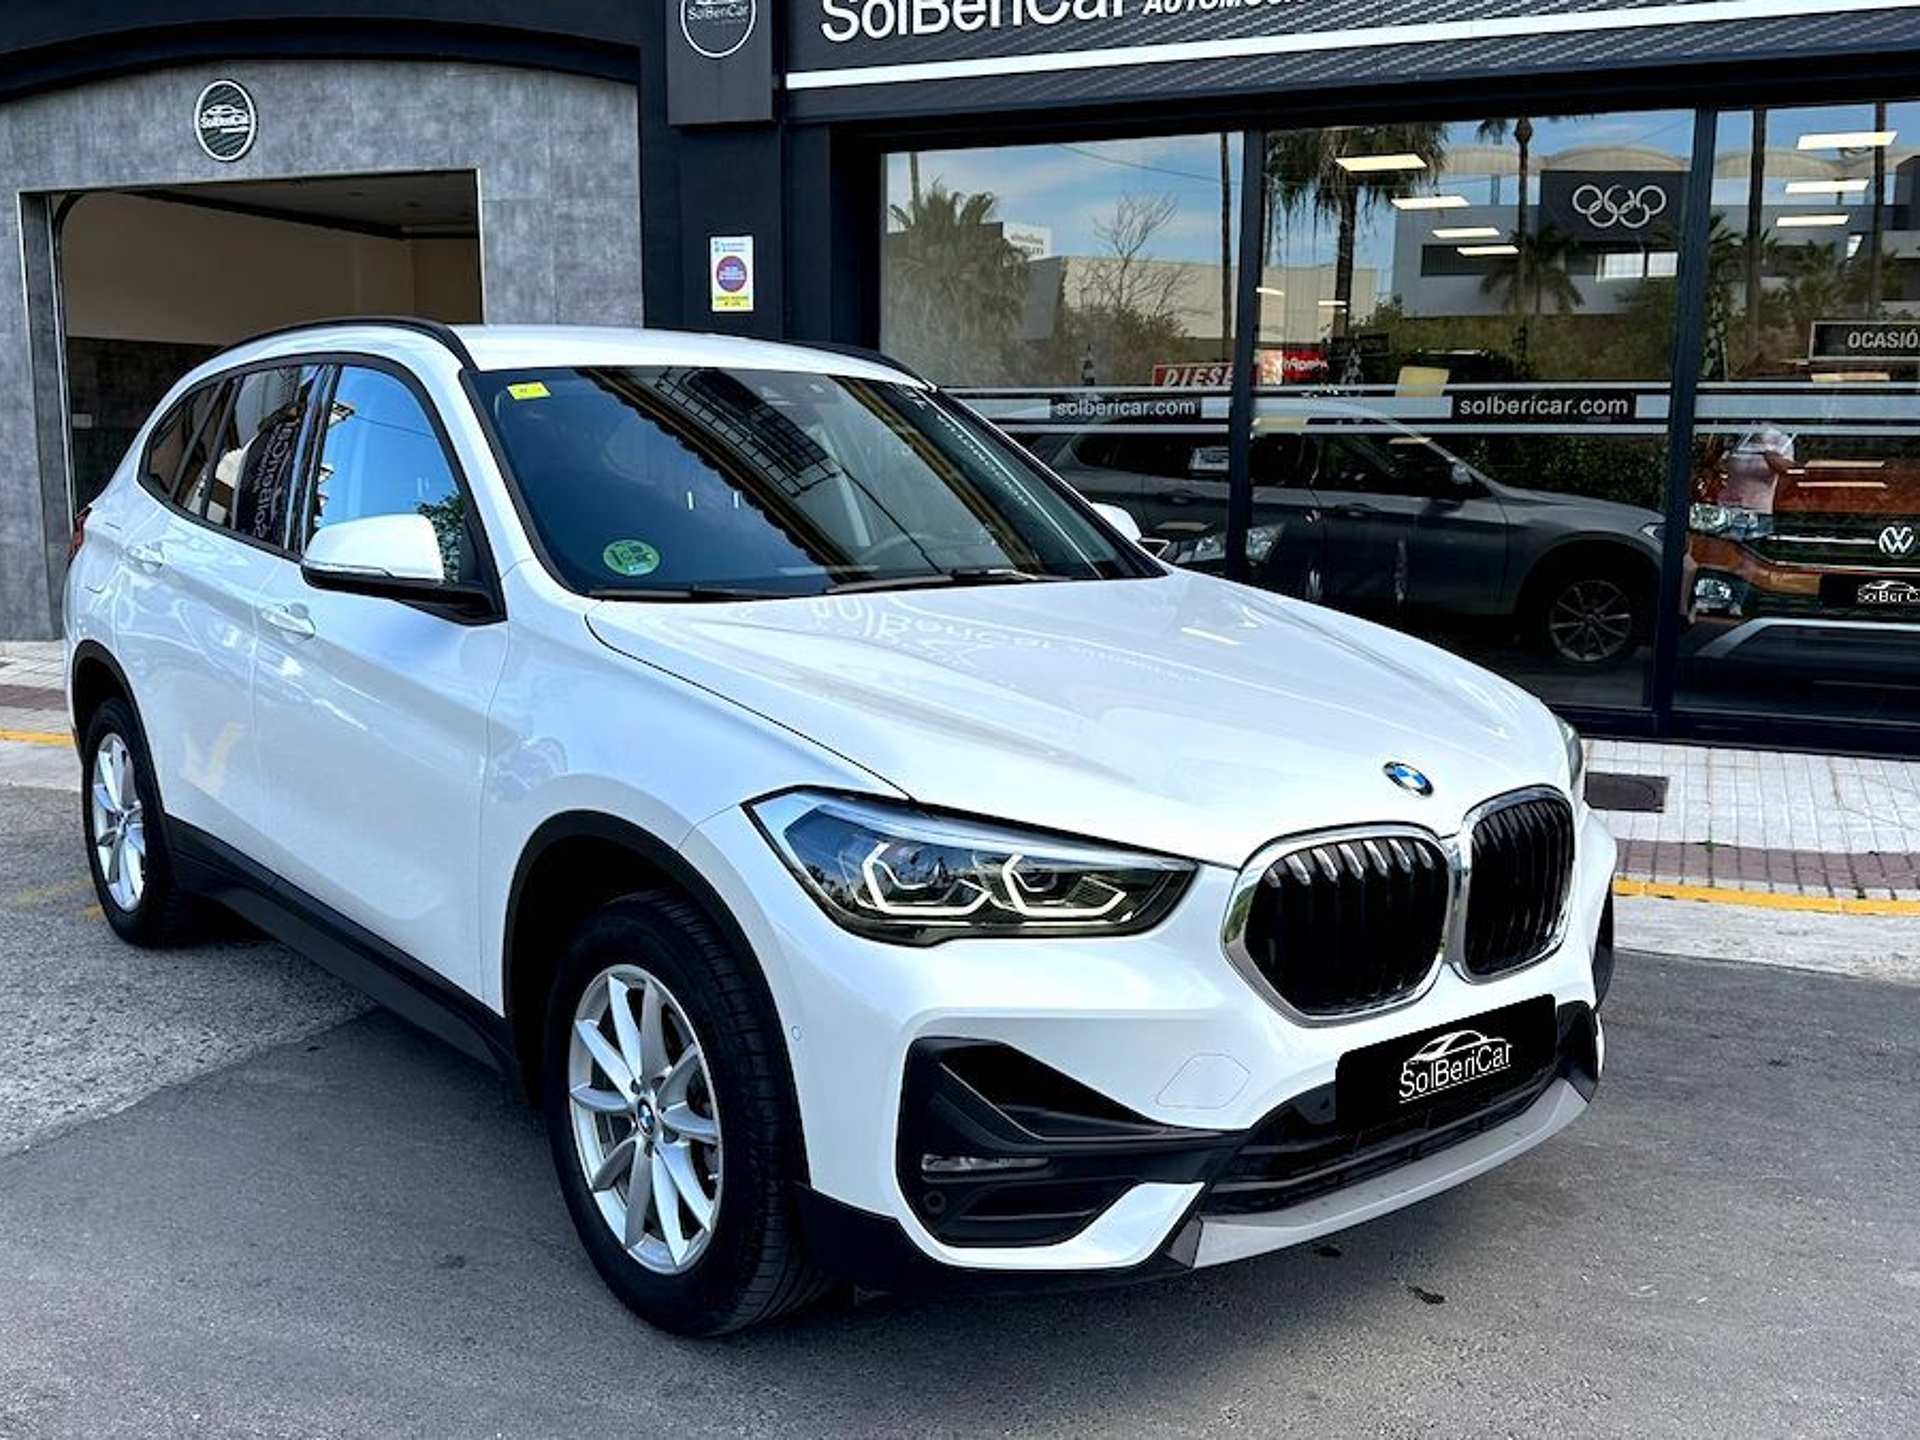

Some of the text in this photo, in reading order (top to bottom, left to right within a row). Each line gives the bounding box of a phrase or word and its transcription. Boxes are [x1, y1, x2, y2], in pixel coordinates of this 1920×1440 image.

[1847, 328, 1920, 349] OCASIÓ
[1162, 366, 1234, 387] DIESE
[1057, 399, 1196, 416] solbericar.com
[1459, 396, 1628, 415] solbericar.com
[1857, 588, 1920, 603] SolBerC
[1398, 1043, 1513, 1098] SolBeriCar
